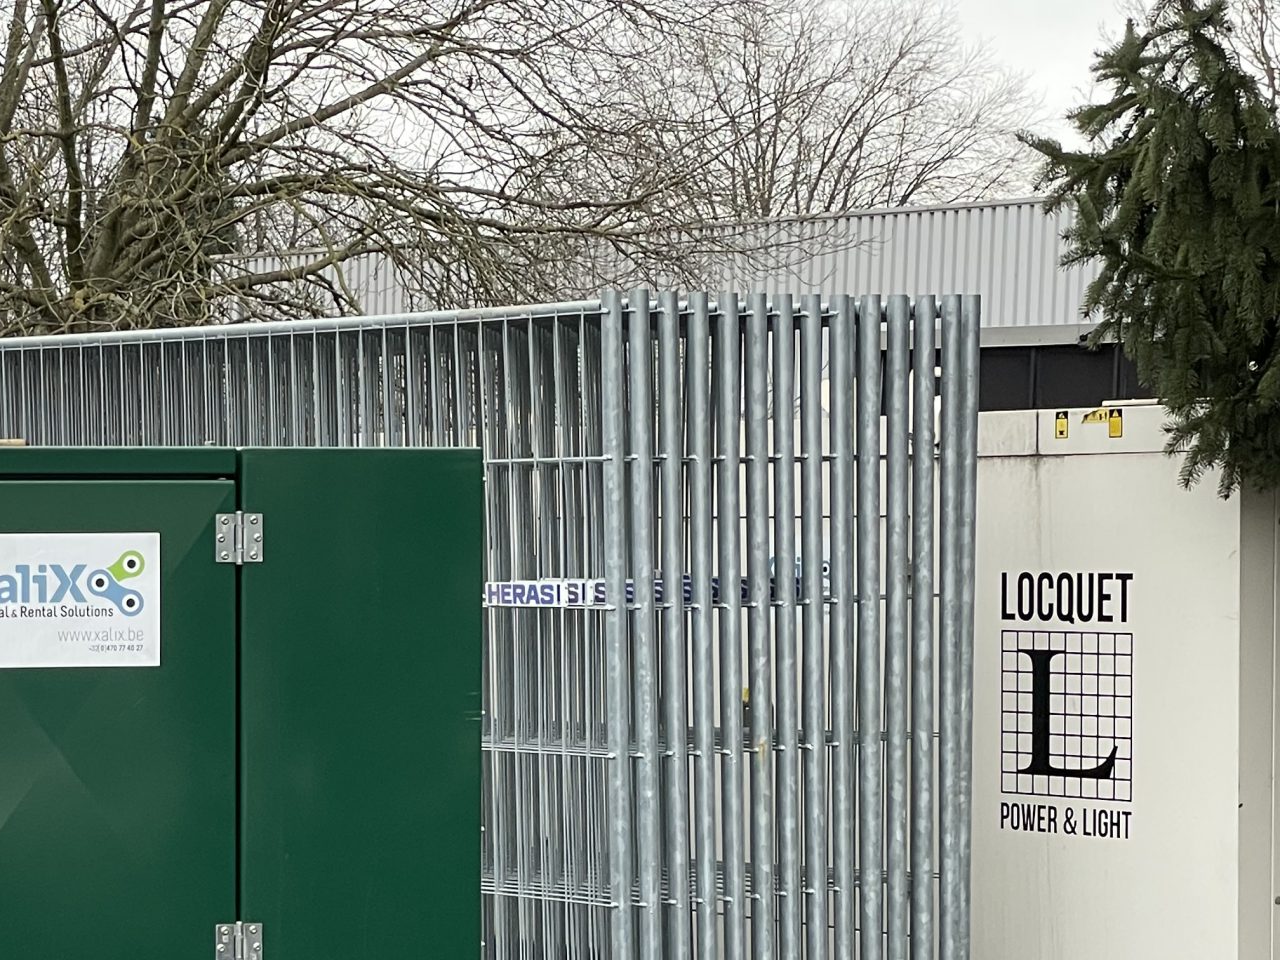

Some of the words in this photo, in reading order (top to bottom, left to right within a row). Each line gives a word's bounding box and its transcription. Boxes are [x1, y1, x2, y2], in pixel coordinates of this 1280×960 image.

[487, 583, 555, 605] HERAS
[1001, 572, 1133, 624] LOCQUET
[11, 609, 18, 618] &
[20, 605, 58, 618] Rental
[60, 605, 114, 618] Solutions
[57, 627, 144, 643] www.xalix.be
[1016, 649, 1119, 779] L
[1000, 802, 1058, 834] POWER
[1063, 806, 1078, 835] &
[1082, 808, 1133, 840] LIGHT
